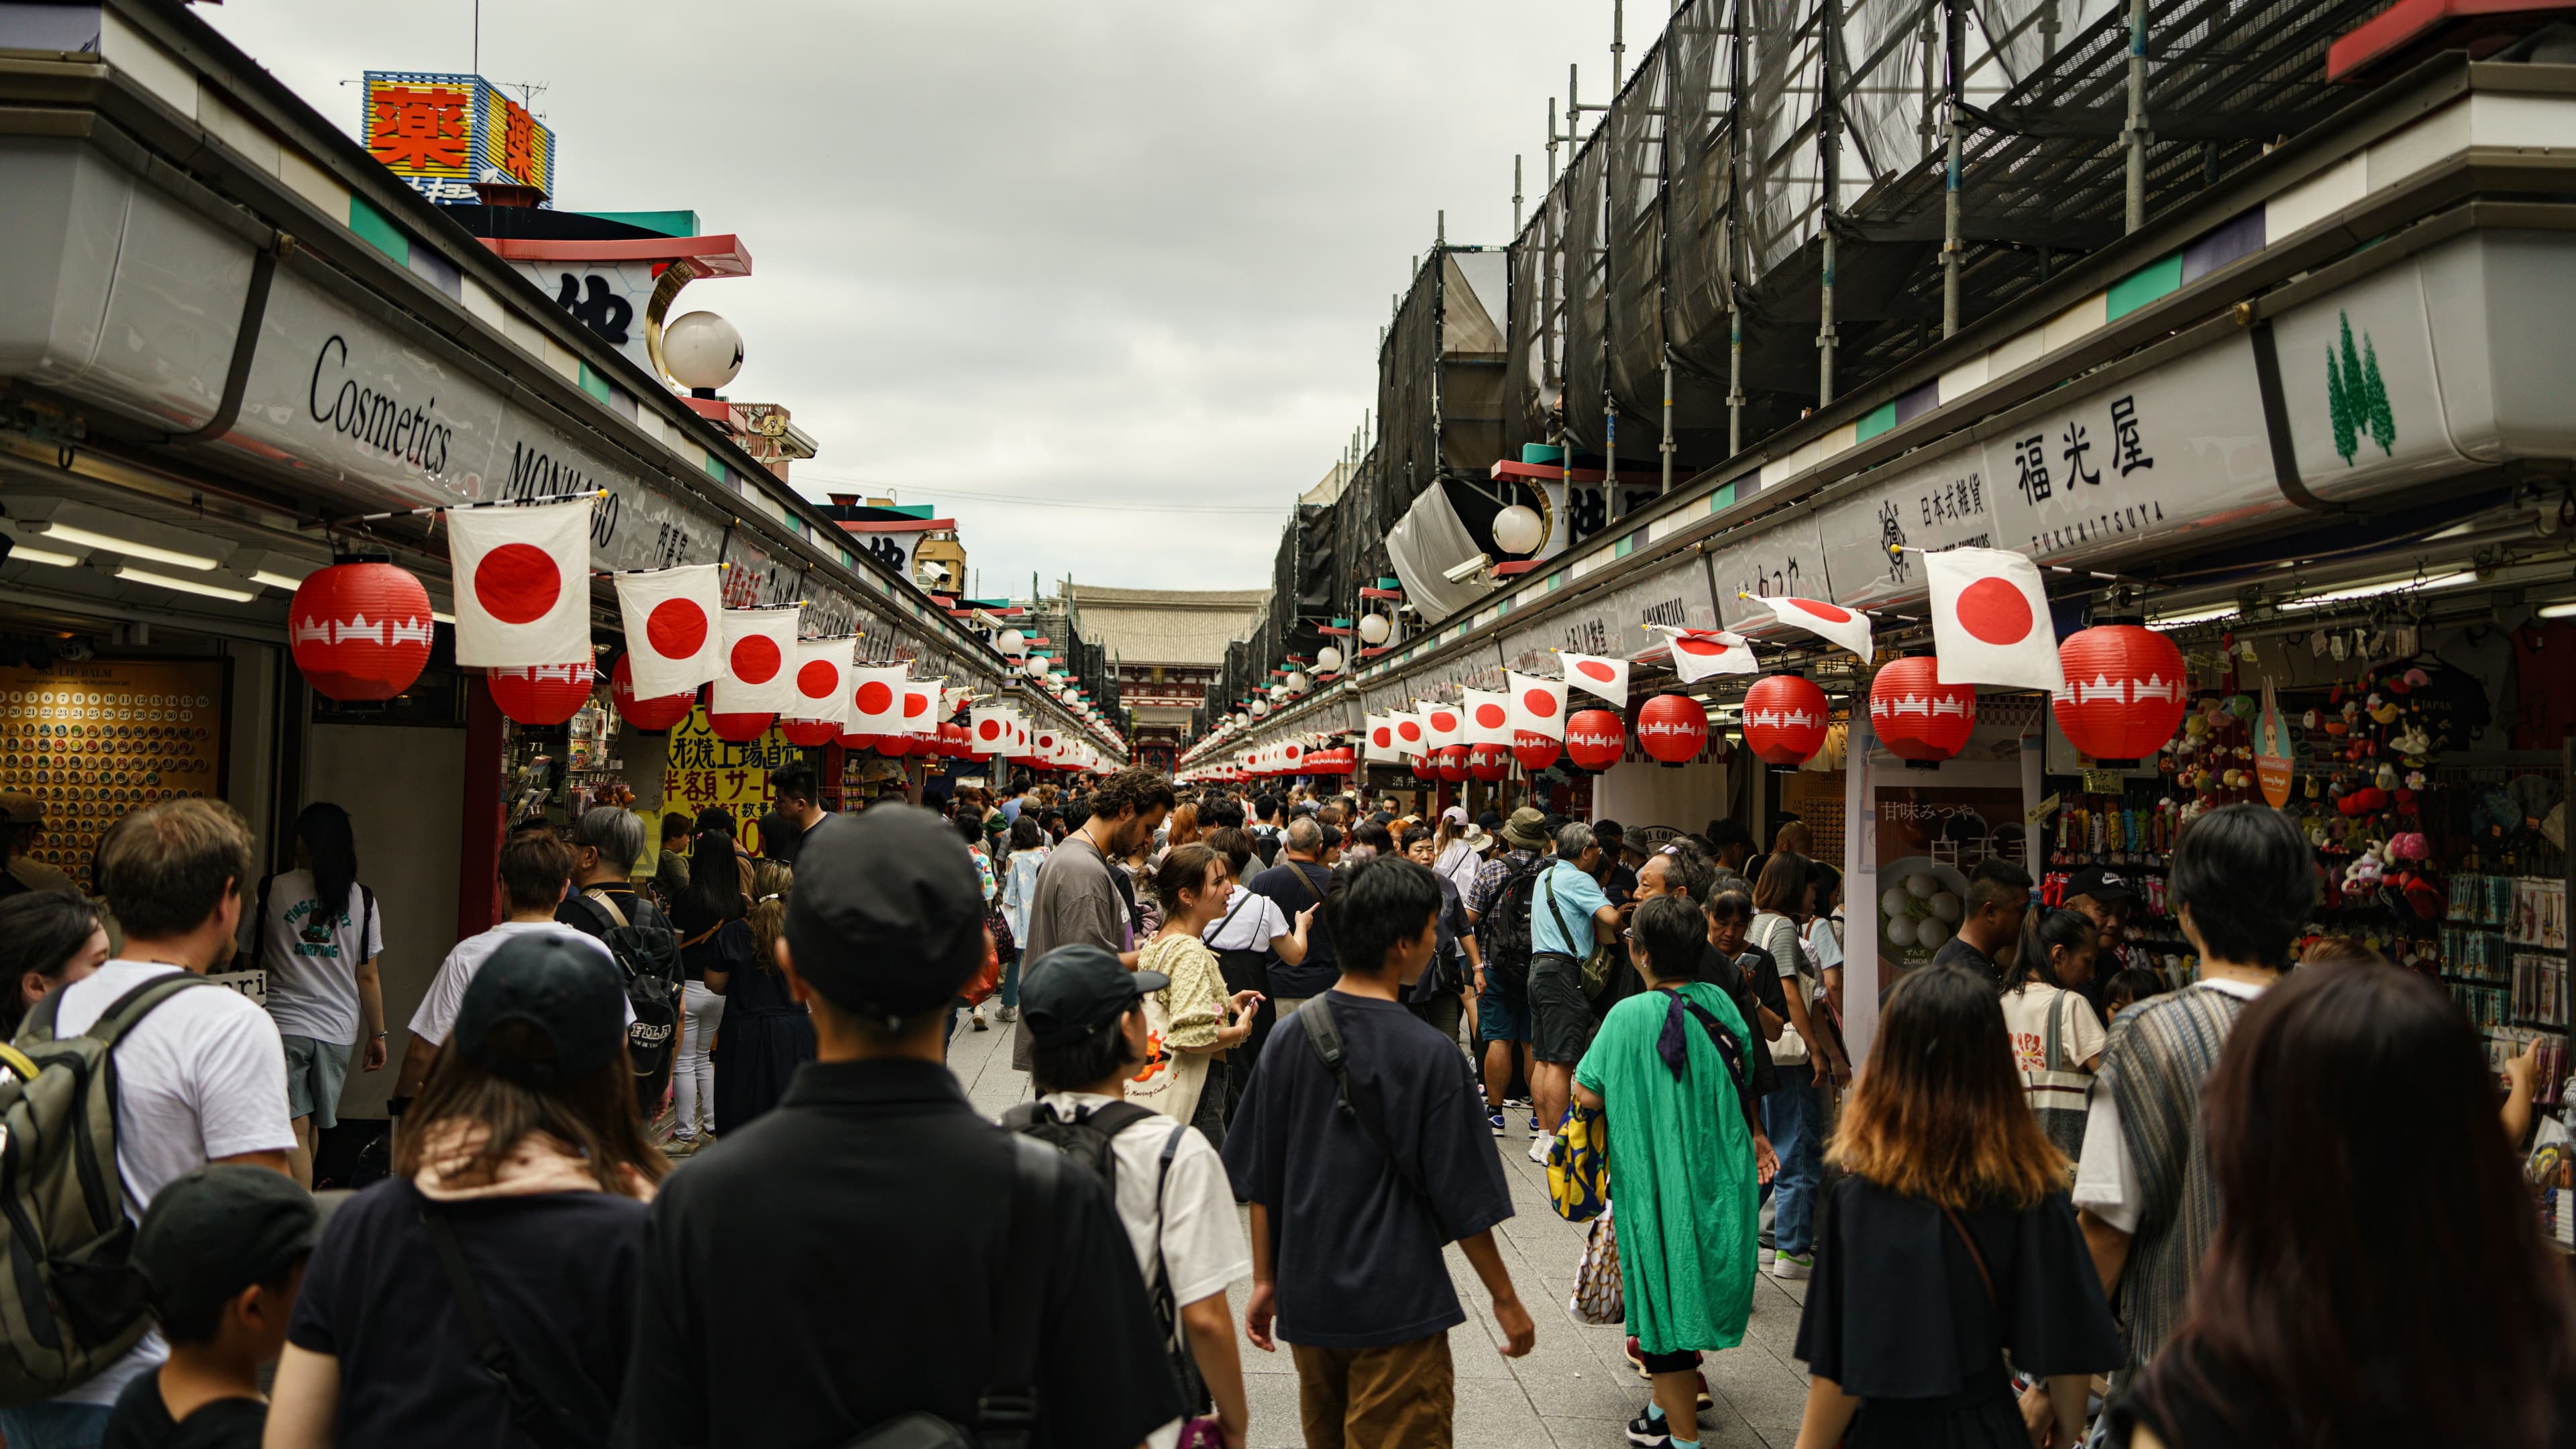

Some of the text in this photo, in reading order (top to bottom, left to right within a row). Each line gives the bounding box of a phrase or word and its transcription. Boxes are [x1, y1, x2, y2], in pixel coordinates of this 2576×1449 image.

[370, 87, 468, 168] 薬
[504, 100, 535, 184] 薬
[309, 334, 452, 474] Cosmetics
[2015, 394, 2153, 506] 福光屋
[501, 440, 619, 548] MONKDO
[1920, 472, 1984, 527] 日本式雑貨
[1642, 596, 1686, 631] COSMETICS
[1880, 800, 1976, 822] 甘味みつや
[630, 1022, 672, 1040] FILA
